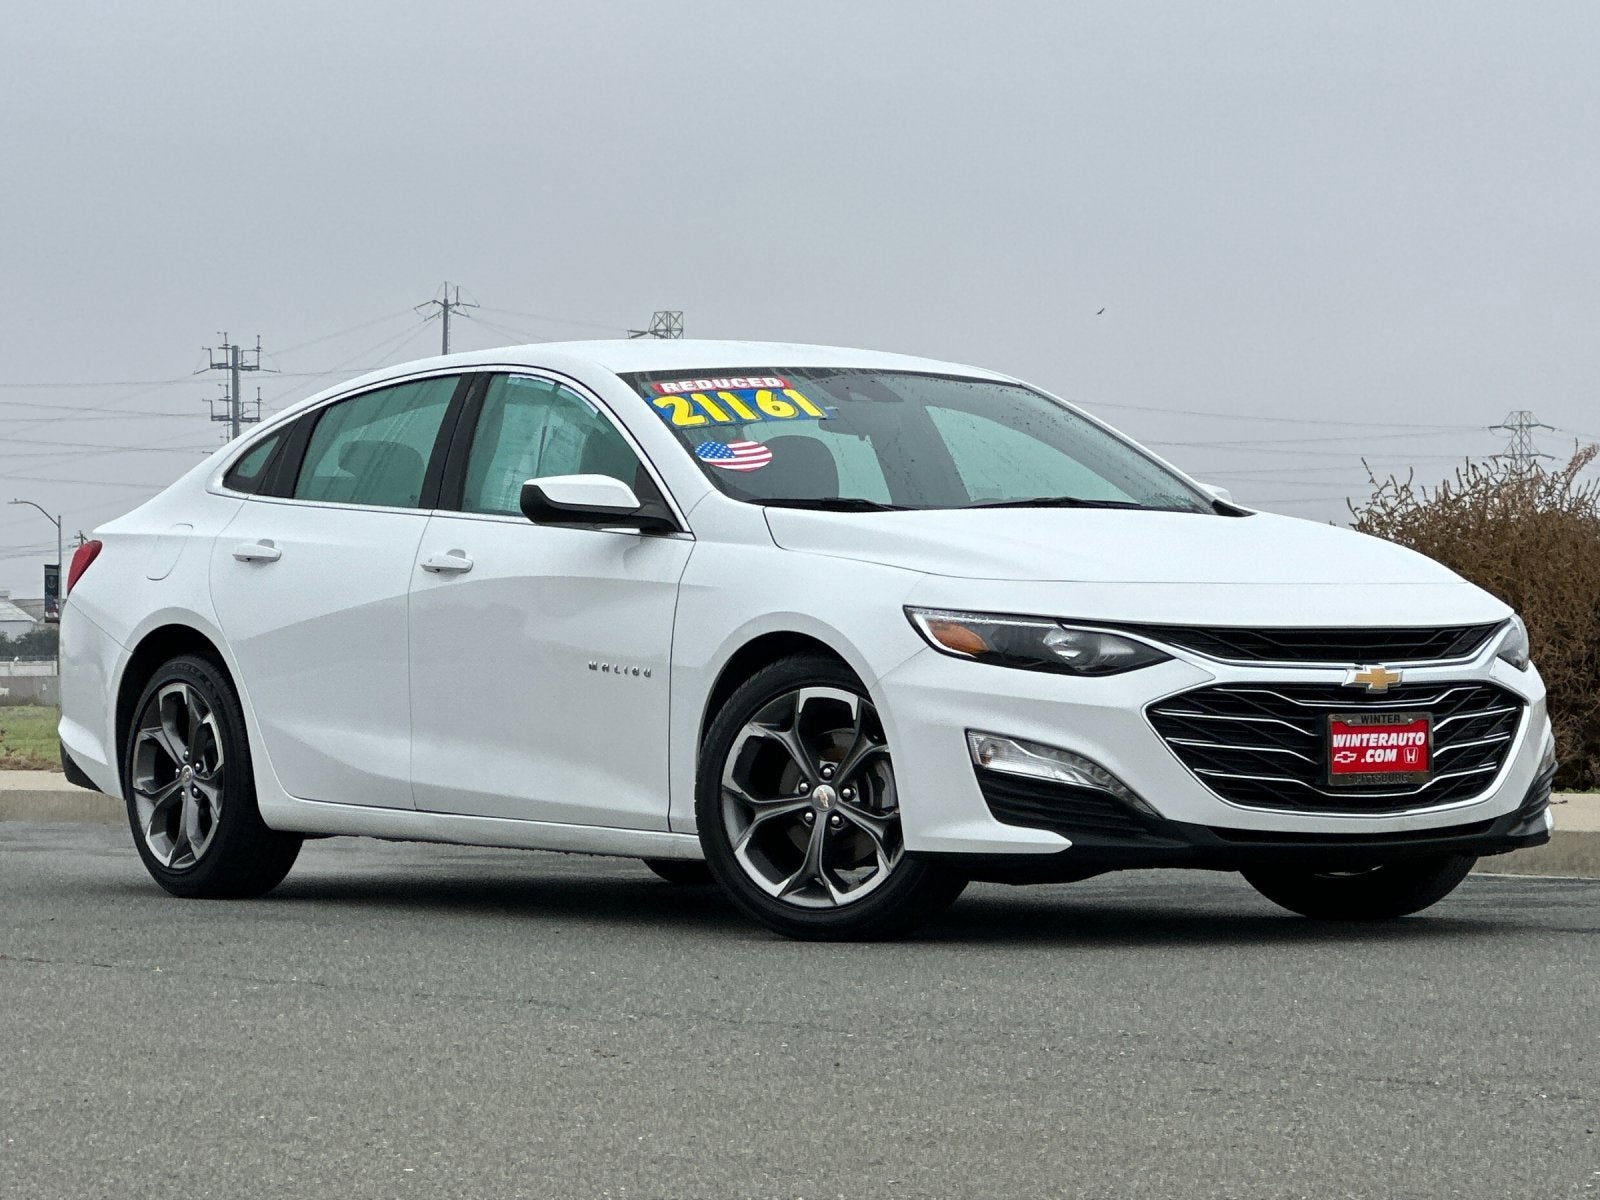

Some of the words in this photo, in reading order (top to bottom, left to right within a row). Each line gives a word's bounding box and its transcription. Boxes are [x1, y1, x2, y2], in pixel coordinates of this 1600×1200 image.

[660, 377, 784, 393] REDUCED
[653, 389, 824, 426] 21161
[588, 661, 652, 678] MALIBU
[1360, 714, 1400, 724] WINTER
[1333, 732, 1425, 747] WINTERAUTO
[1360, 749, 1398, 763] .COM
